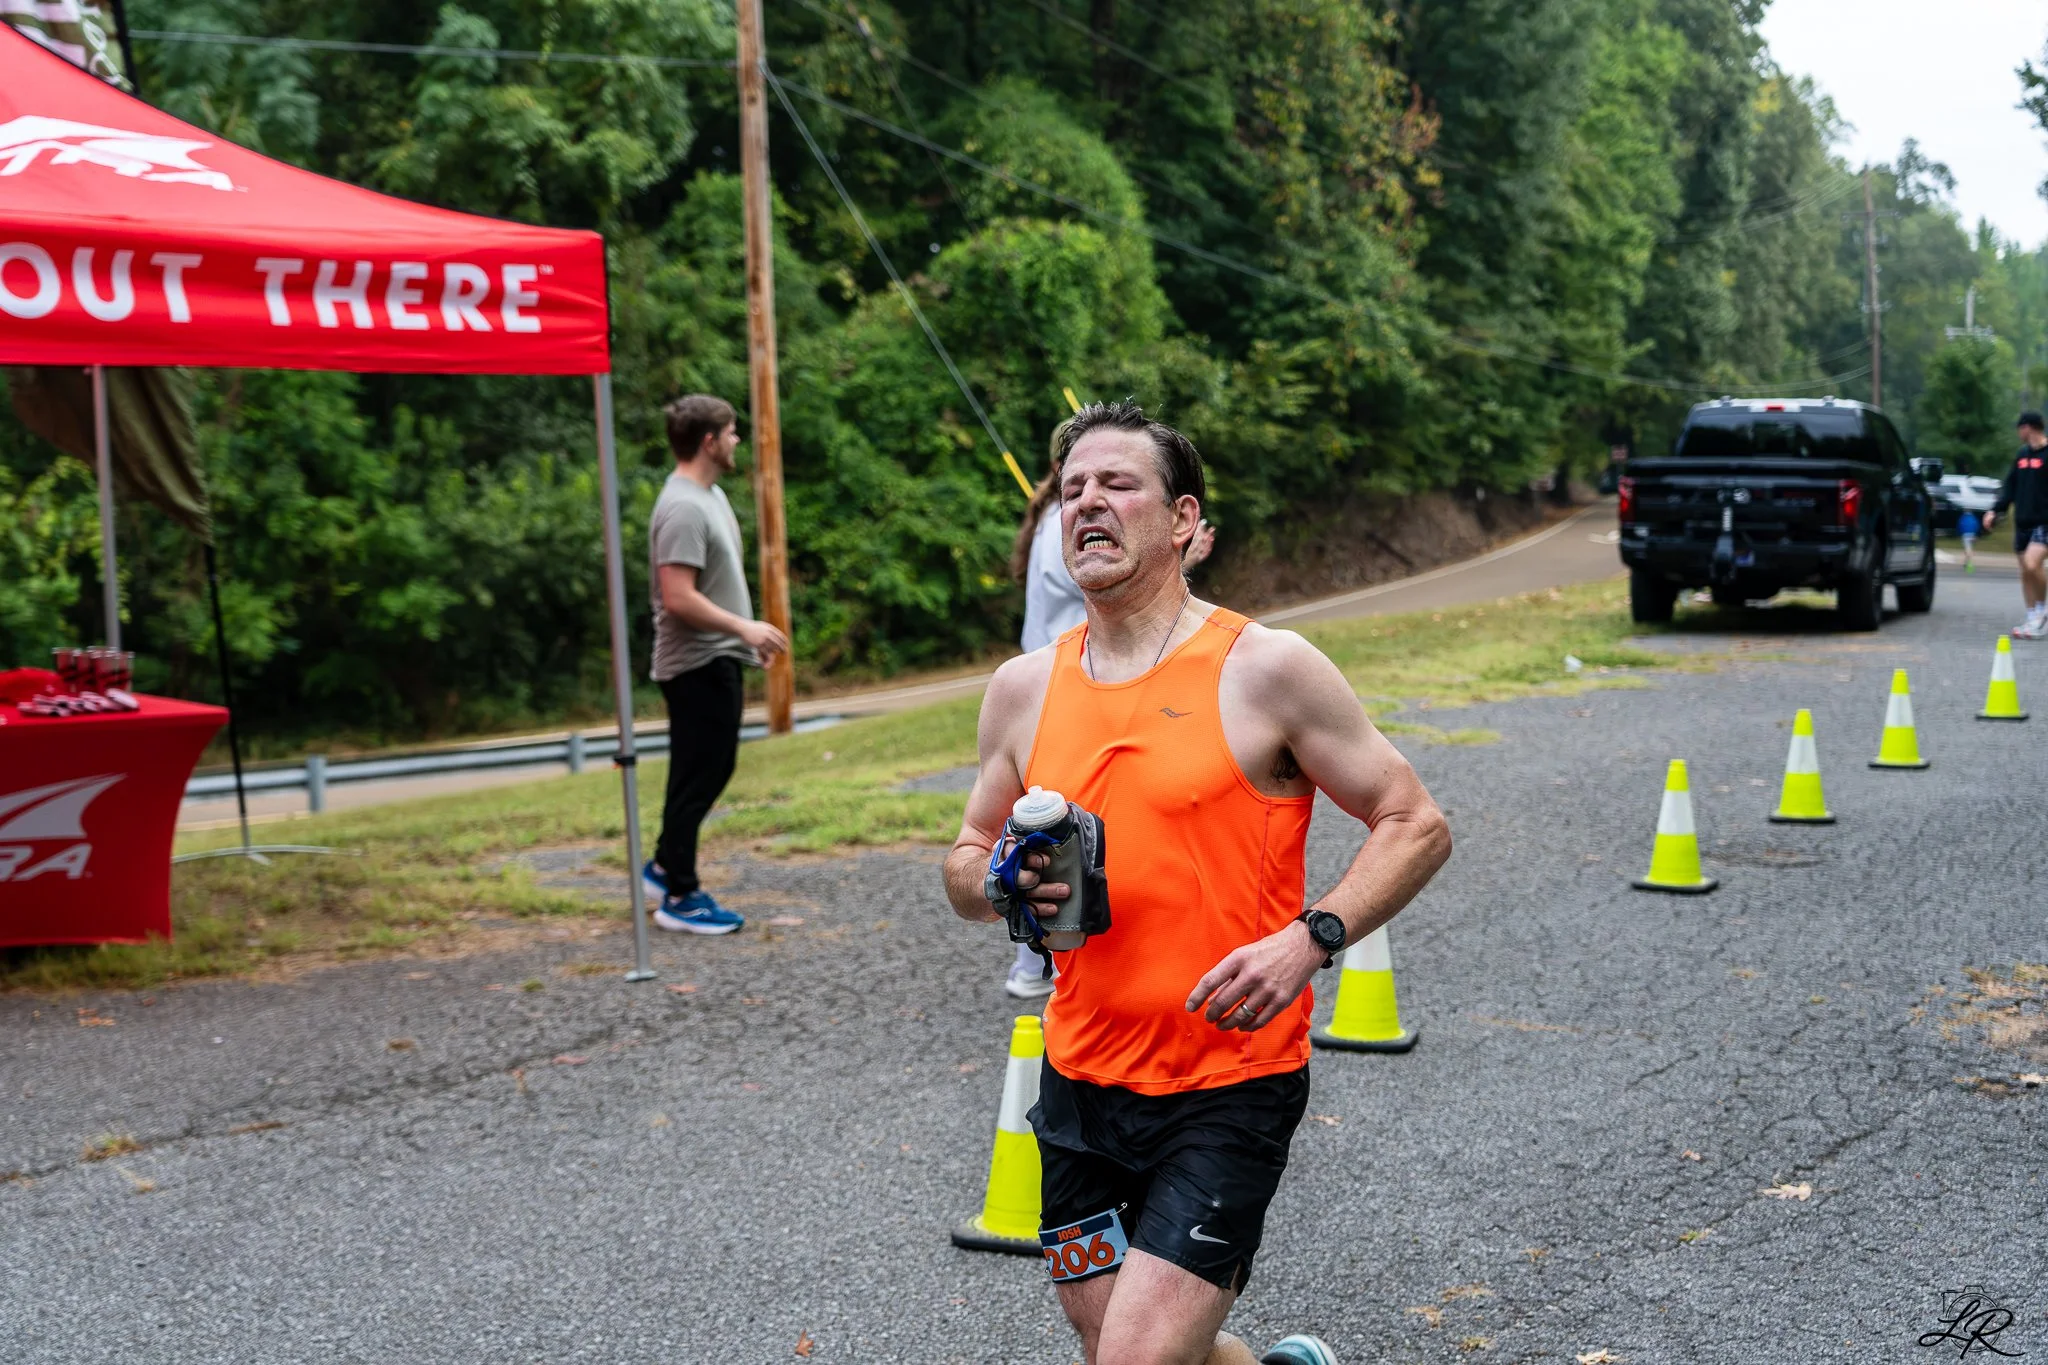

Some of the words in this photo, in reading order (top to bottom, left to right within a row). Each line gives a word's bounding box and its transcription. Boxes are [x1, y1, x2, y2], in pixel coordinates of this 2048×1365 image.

[0, 241, 204, 324] OUT
[1043, 1232, 1115, 1278] 206
[1057, 1226, 1082, 1242] JOSH
